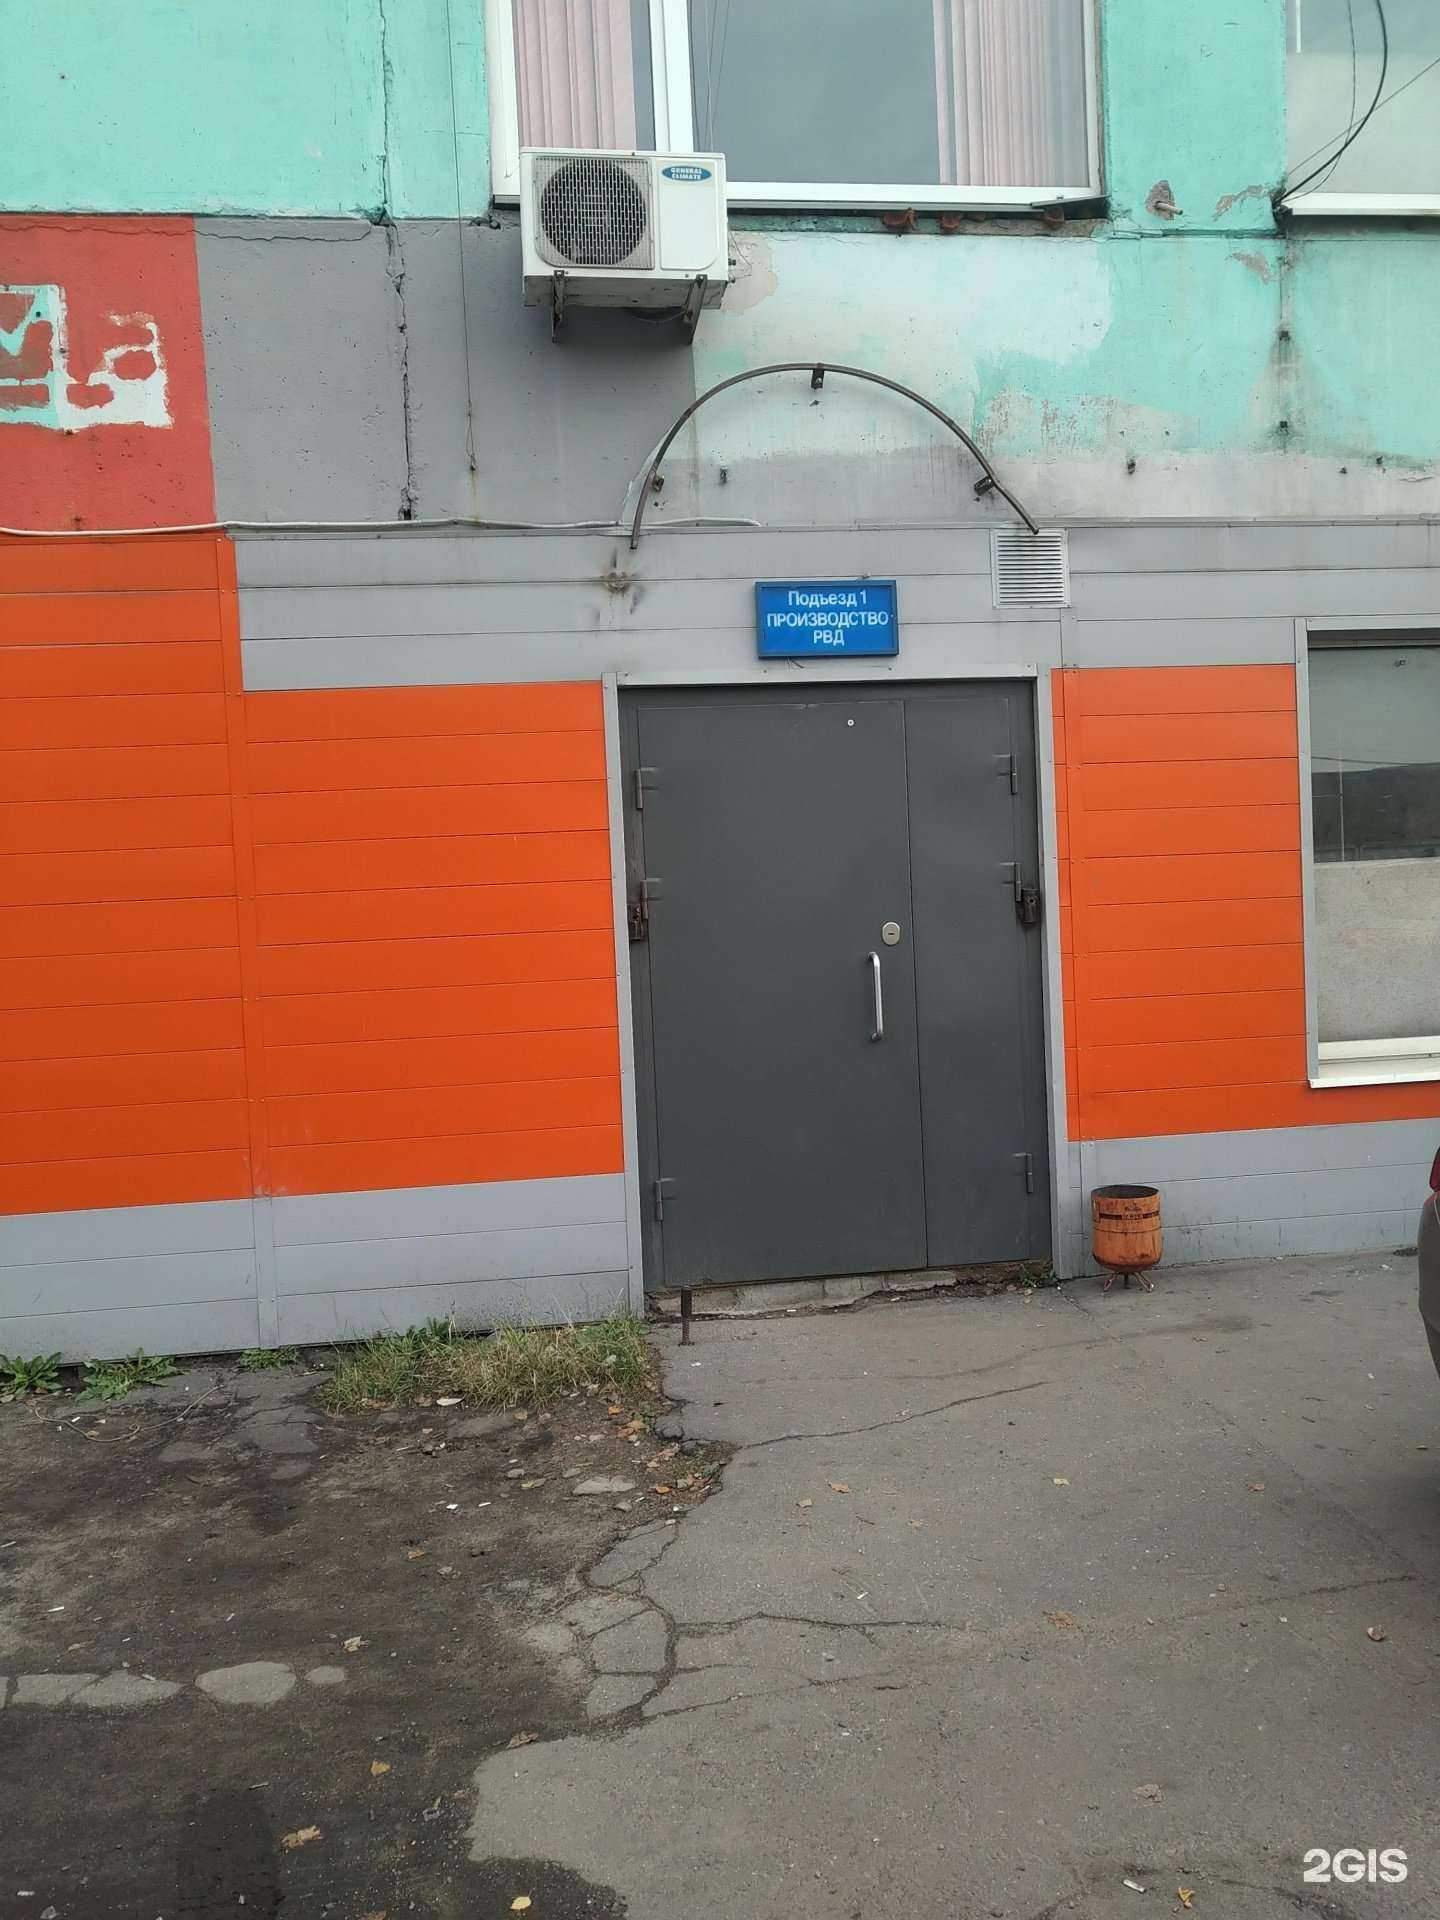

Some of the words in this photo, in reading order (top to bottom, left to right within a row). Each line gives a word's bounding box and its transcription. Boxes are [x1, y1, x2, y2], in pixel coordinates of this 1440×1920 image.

[788, 590, 857, 606] Подъезд
[860, 590, 867, 603] 1
[767, 611, 889, 628] ПРОИЗВОДСТВО
[813, 629, 845, 646] РВД
